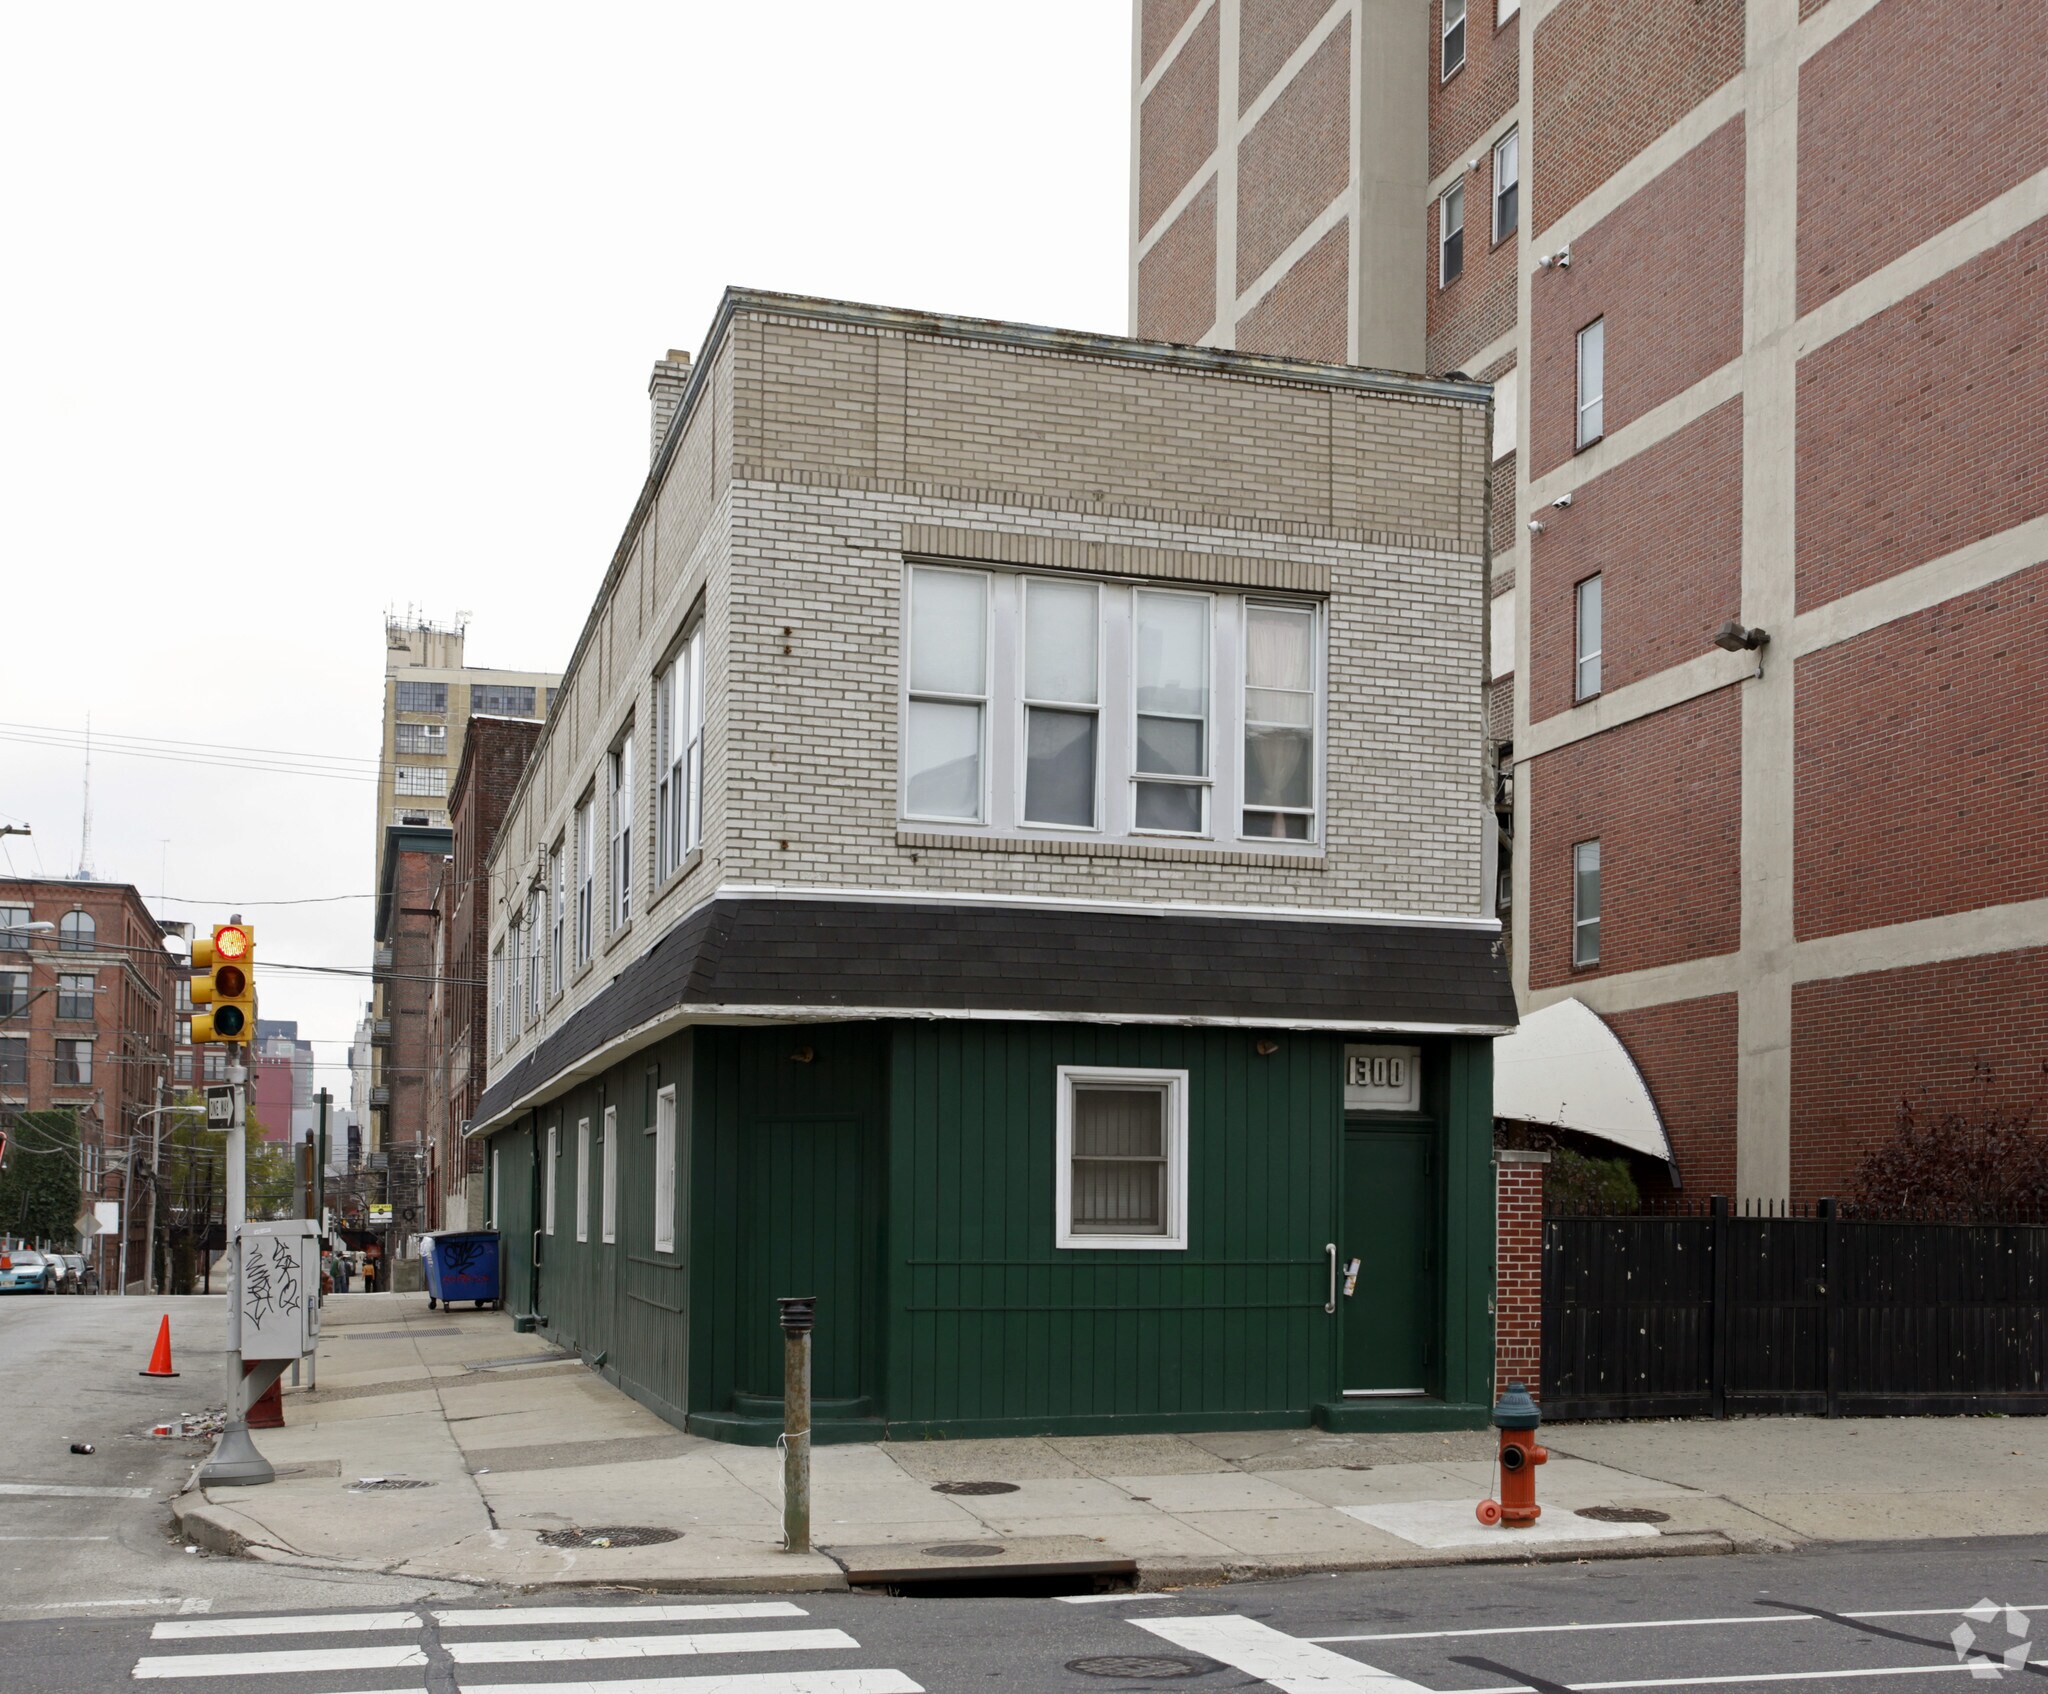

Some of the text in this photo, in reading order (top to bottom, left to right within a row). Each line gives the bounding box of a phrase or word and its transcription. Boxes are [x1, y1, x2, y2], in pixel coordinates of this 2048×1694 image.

[1348, 1056, 1404, 1086] 1300
[209, 1098, 229, 1117] ONE WAY
